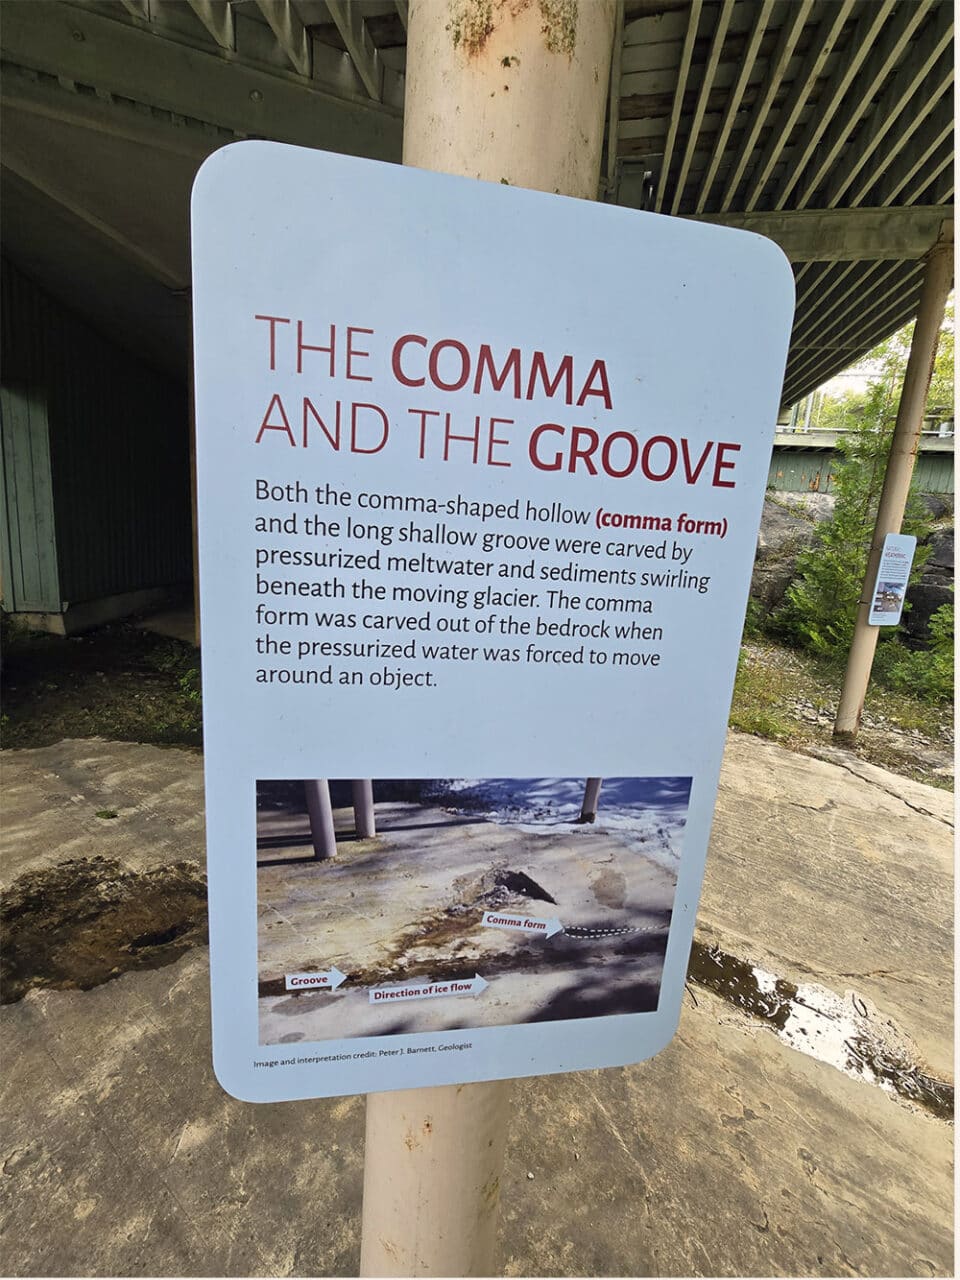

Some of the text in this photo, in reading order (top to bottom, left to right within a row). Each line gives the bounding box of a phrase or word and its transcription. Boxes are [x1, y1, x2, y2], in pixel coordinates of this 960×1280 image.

[254, 314, 613, 410] THE COMMA
[255, 393, 741, 488] AND THE GROOVE
[256, 479, 727, 539] Both the comma-shaped hollow (comma form)
[254, 512, 693, 565] and the long shallow groove were carved by
[255, 548, 711, 594] pressurized meltwater and sediments swirling
[256, 573, 652, 613] beneath the moving glacier. The comma
[255, 603, 662, 640] form was carved out of the bedrock when
[255, 633, 660, 666] the pressurized water was forced to move
[255, 664, 437, 690] around an object.
[486, 914, 546, 929] Comma form
[290, 976, 328, 986] Groove
[374, 983, 472, 1000] Direction of ice flow
